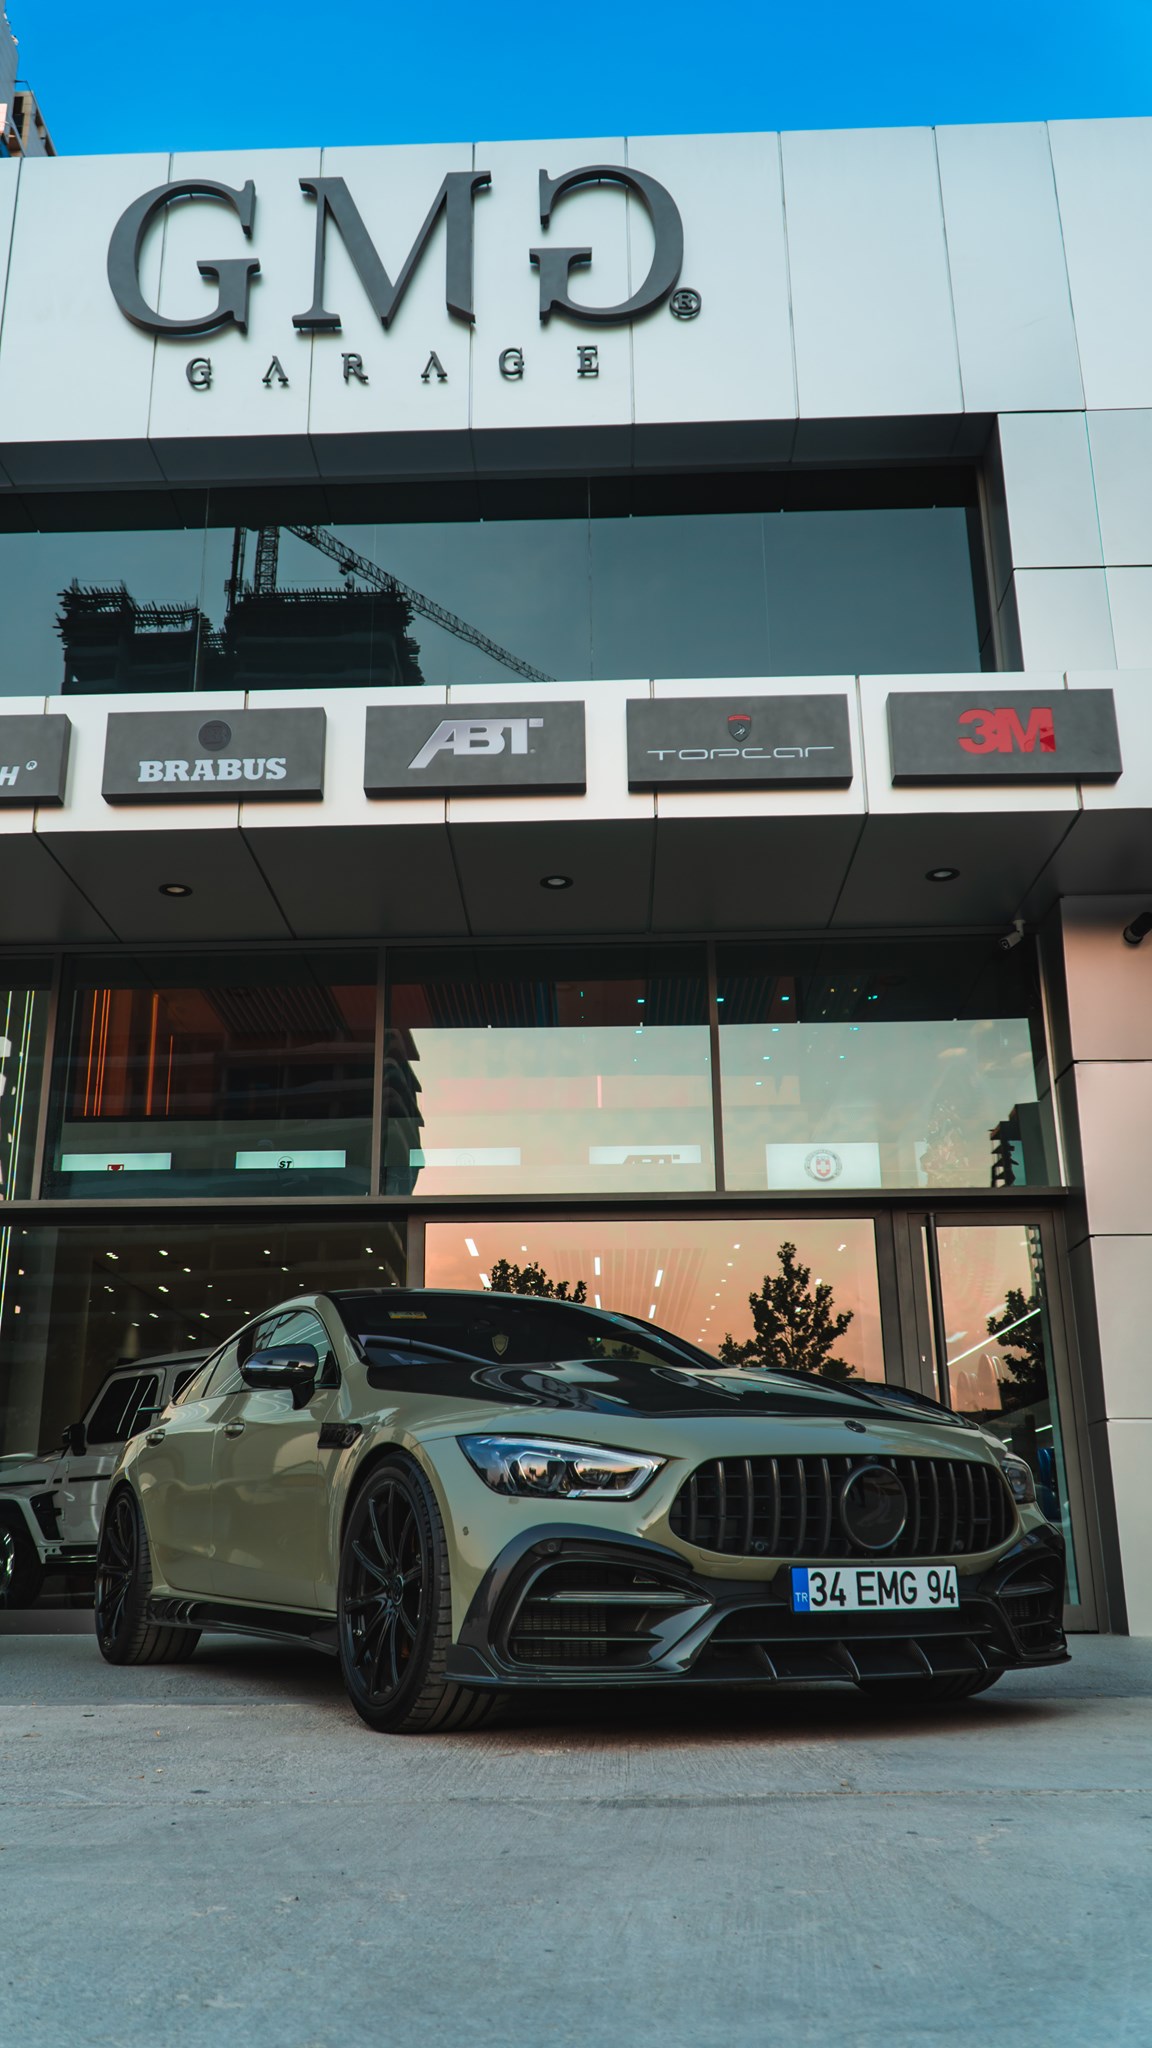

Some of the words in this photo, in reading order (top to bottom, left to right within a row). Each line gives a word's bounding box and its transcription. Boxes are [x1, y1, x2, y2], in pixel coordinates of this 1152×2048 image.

[185, 345, 600, 390] GARAGE
[407, 718, 544, 769] ABT
[957, 706, 1057, 754] 3M
[138, 757, 288, 783] BRABUS
[795, 1592, 808, 1602] TR
[810, 1571, 846, 1607] 34
[856, 1570, 918, 1606] EMG
[927, 1570, 956, 1604] 94
